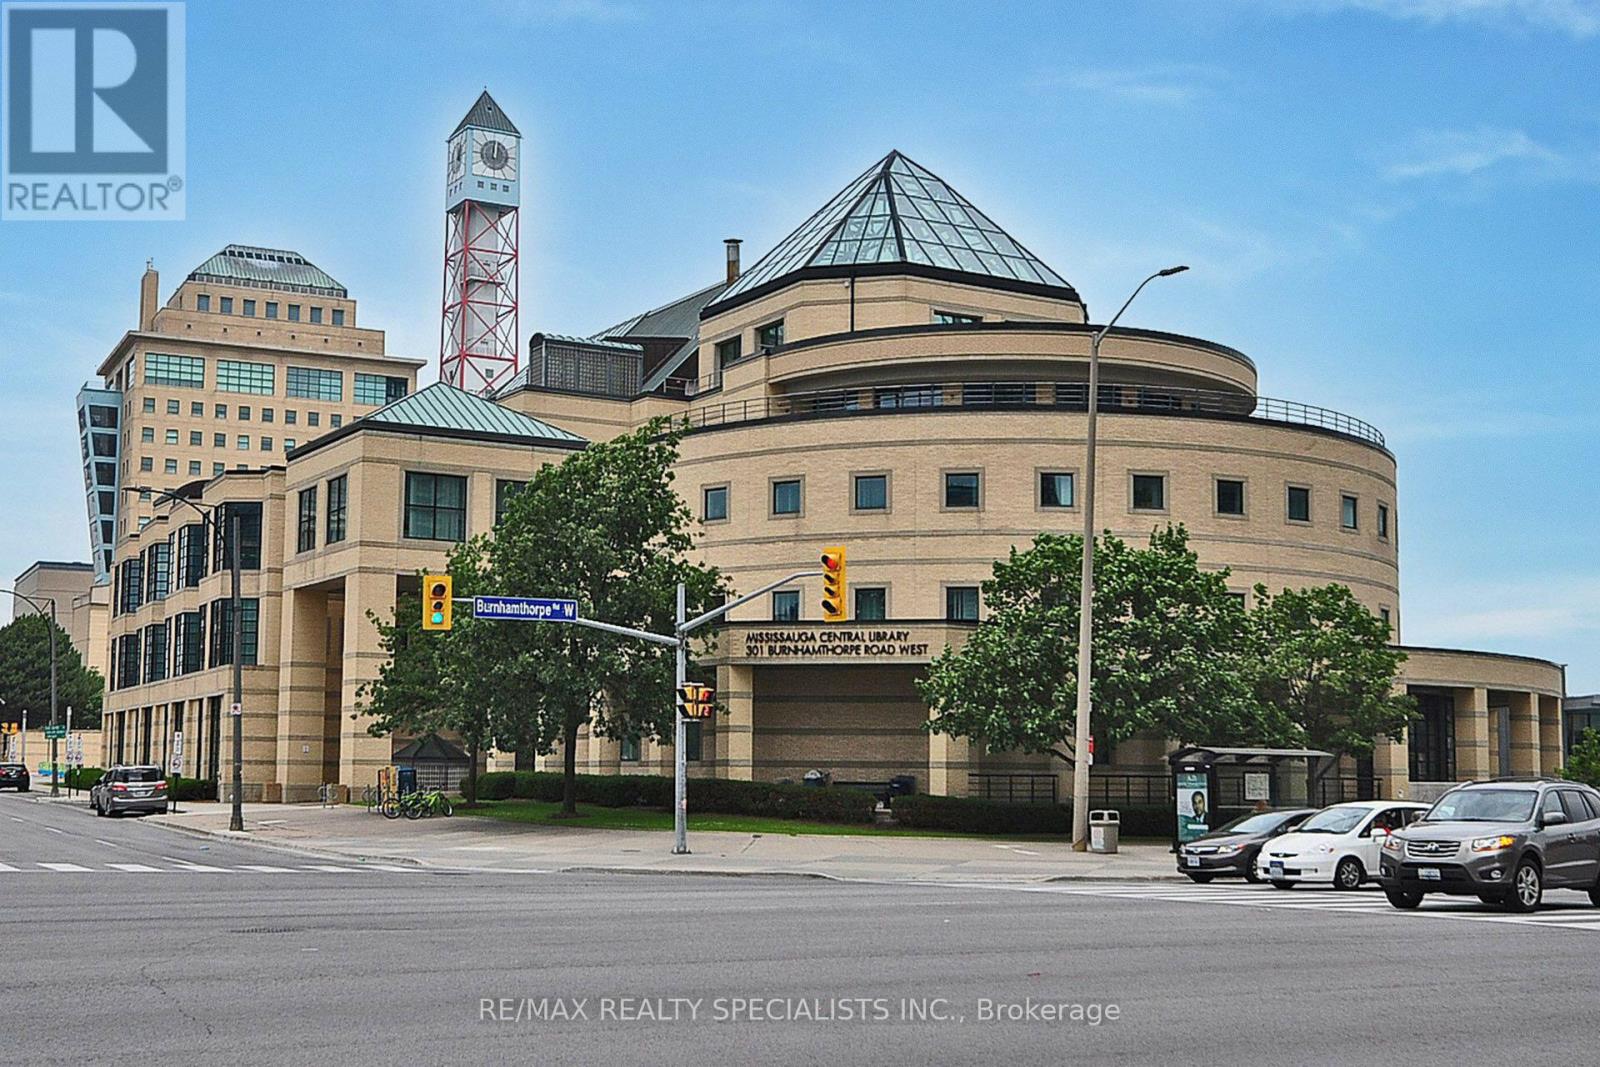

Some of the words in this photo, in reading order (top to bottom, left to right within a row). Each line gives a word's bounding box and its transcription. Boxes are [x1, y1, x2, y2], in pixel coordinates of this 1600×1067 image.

[476, 599, 552, 619] Burnhamthorpe
[564, 603, 575, 617] W
[746, 632, 817, 643] MISSISSAUGA
[819, 631, 866, 643] CENTRAL
[868, 631, 910, 642] LIBRARY
[745, 645, 764, 656] 301
[768, 644, 862, 656] BURNHAMTHORPE
[864, 644, 896, 655] ROAD
[899, 644, 929, 655] WEST
